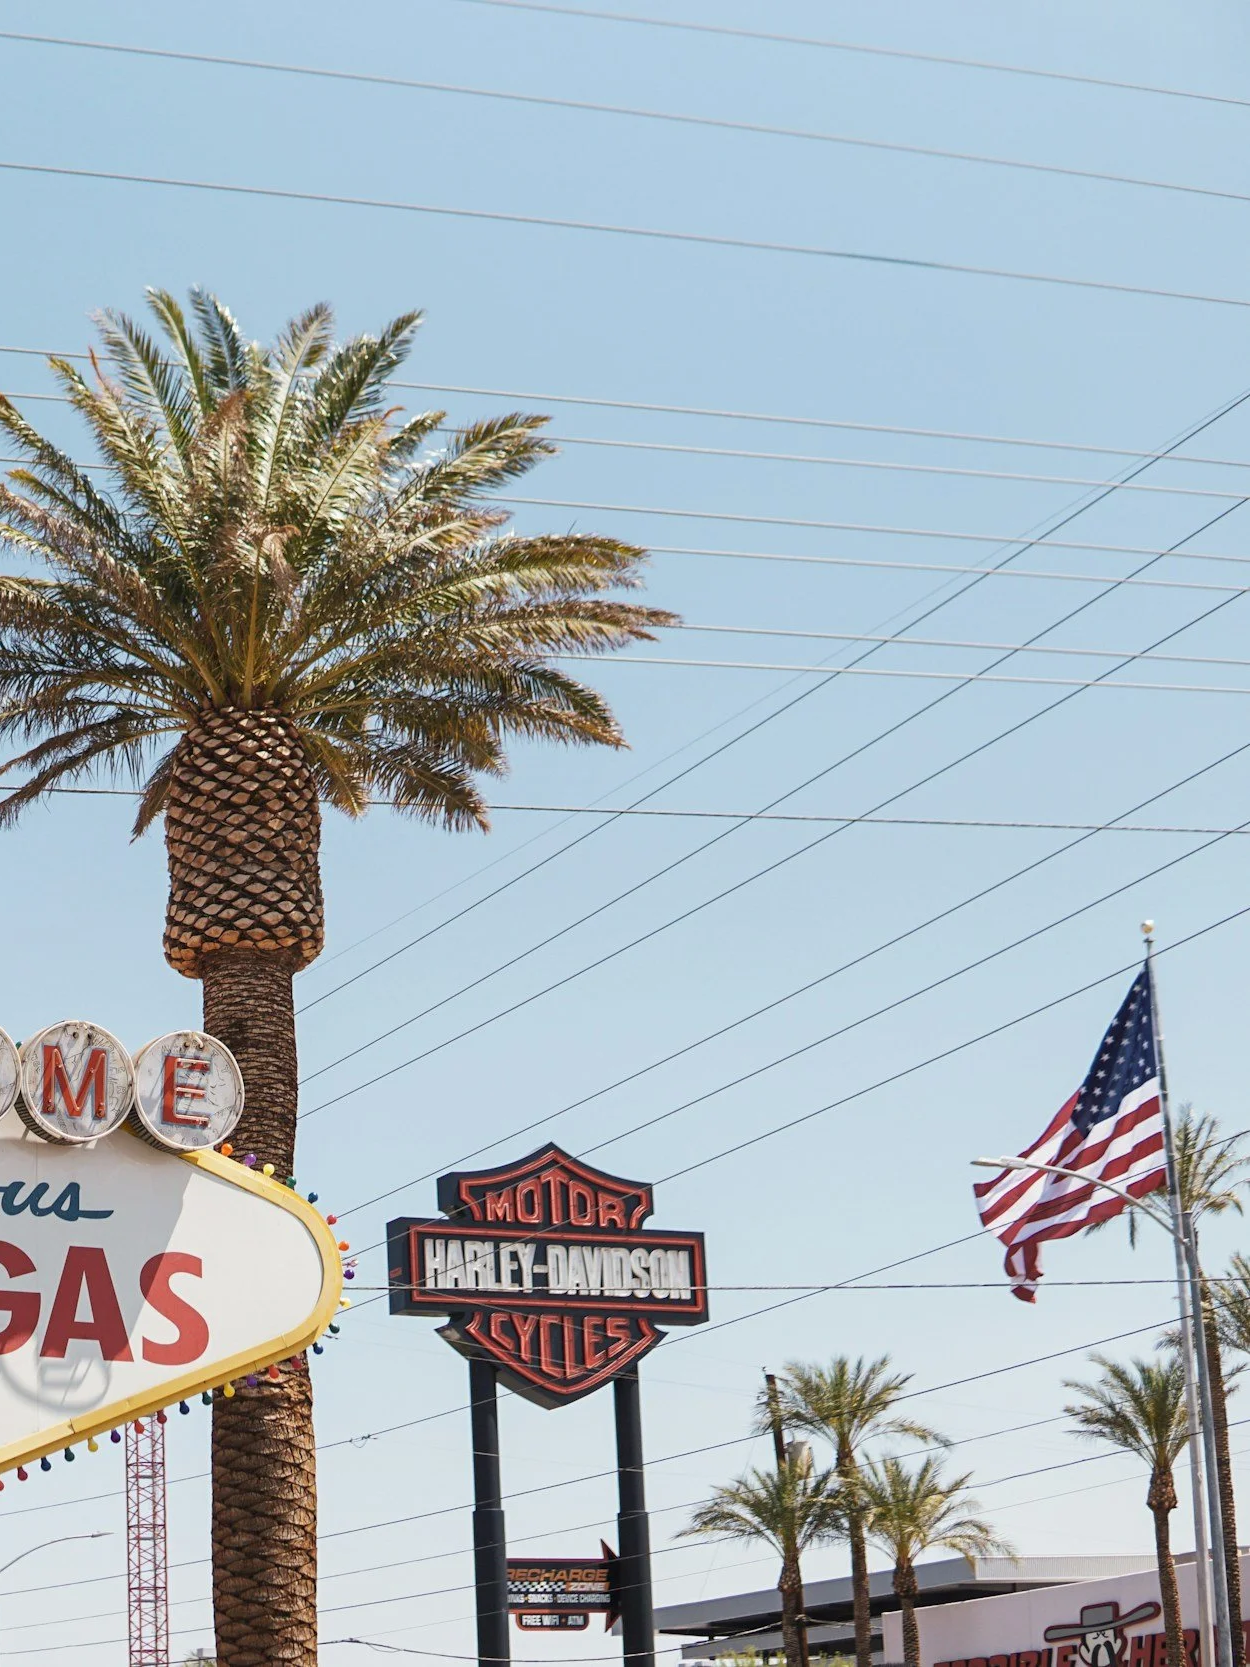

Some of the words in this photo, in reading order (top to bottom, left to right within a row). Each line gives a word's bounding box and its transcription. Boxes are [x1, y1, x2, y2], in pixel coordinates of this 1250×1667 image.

[485, 1166, 627, 1230] MOTOR
[423, 1238, 692, 1300] HARLEY-DAVIDSON
[489, 1312, 630, 1379] CYCLES
[568, 1582, 606, 1592] ZONE
[521, 1615, 541, 1626] FREE
[567, 1615, 585, 1626] ATM
